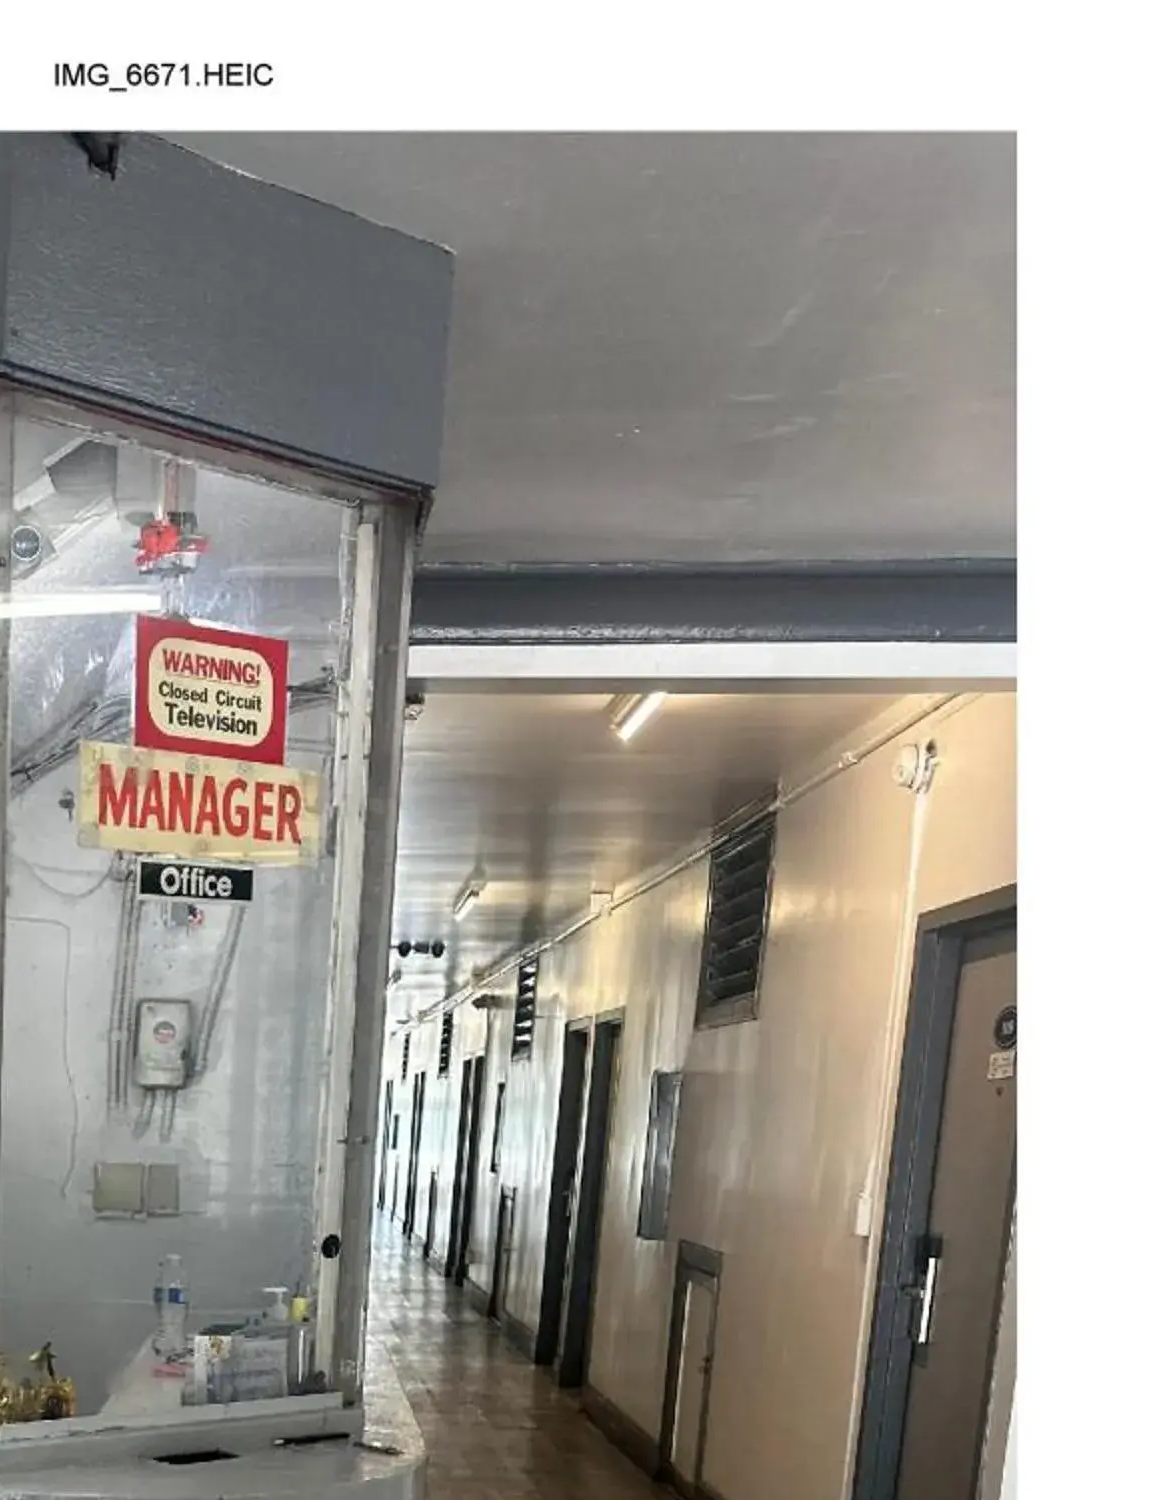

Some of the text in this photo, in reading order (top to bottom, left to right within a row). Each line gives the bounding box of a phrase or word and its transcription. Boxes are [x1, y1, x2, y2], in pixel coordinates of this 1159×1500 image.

[162, 648, 262, 685] WARNING!
[158, 680, 262, 713] Closed Circuit
[164, 702, 258, 736] Television
[97, 763, 302, 845] MANAGER
[159, 866, 233, 897] Office
